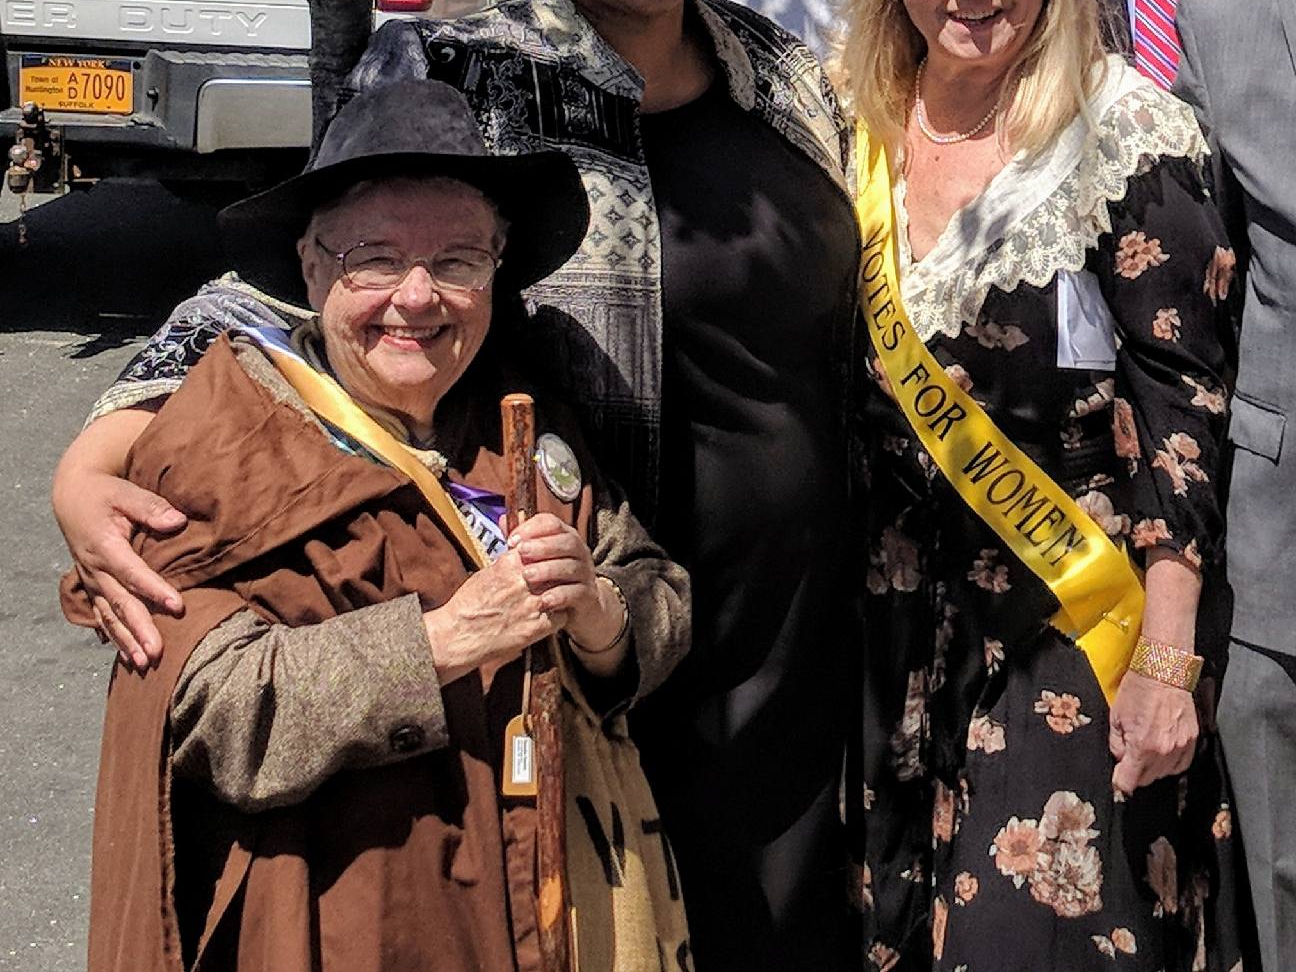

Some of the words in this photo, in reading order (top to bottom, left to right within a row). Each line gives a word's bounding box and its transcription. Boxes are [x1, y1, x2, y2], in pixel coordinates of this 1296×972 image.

[118, 4, 268, 37] DUTY
[48, 58, 75, 68] NEW
[77, 59, 106, 69] YORK
[862, 222, 906, 351] VOTES
[901, 362, 968, 442] FOR
[962, 441, 1090, 568] WOMEN
